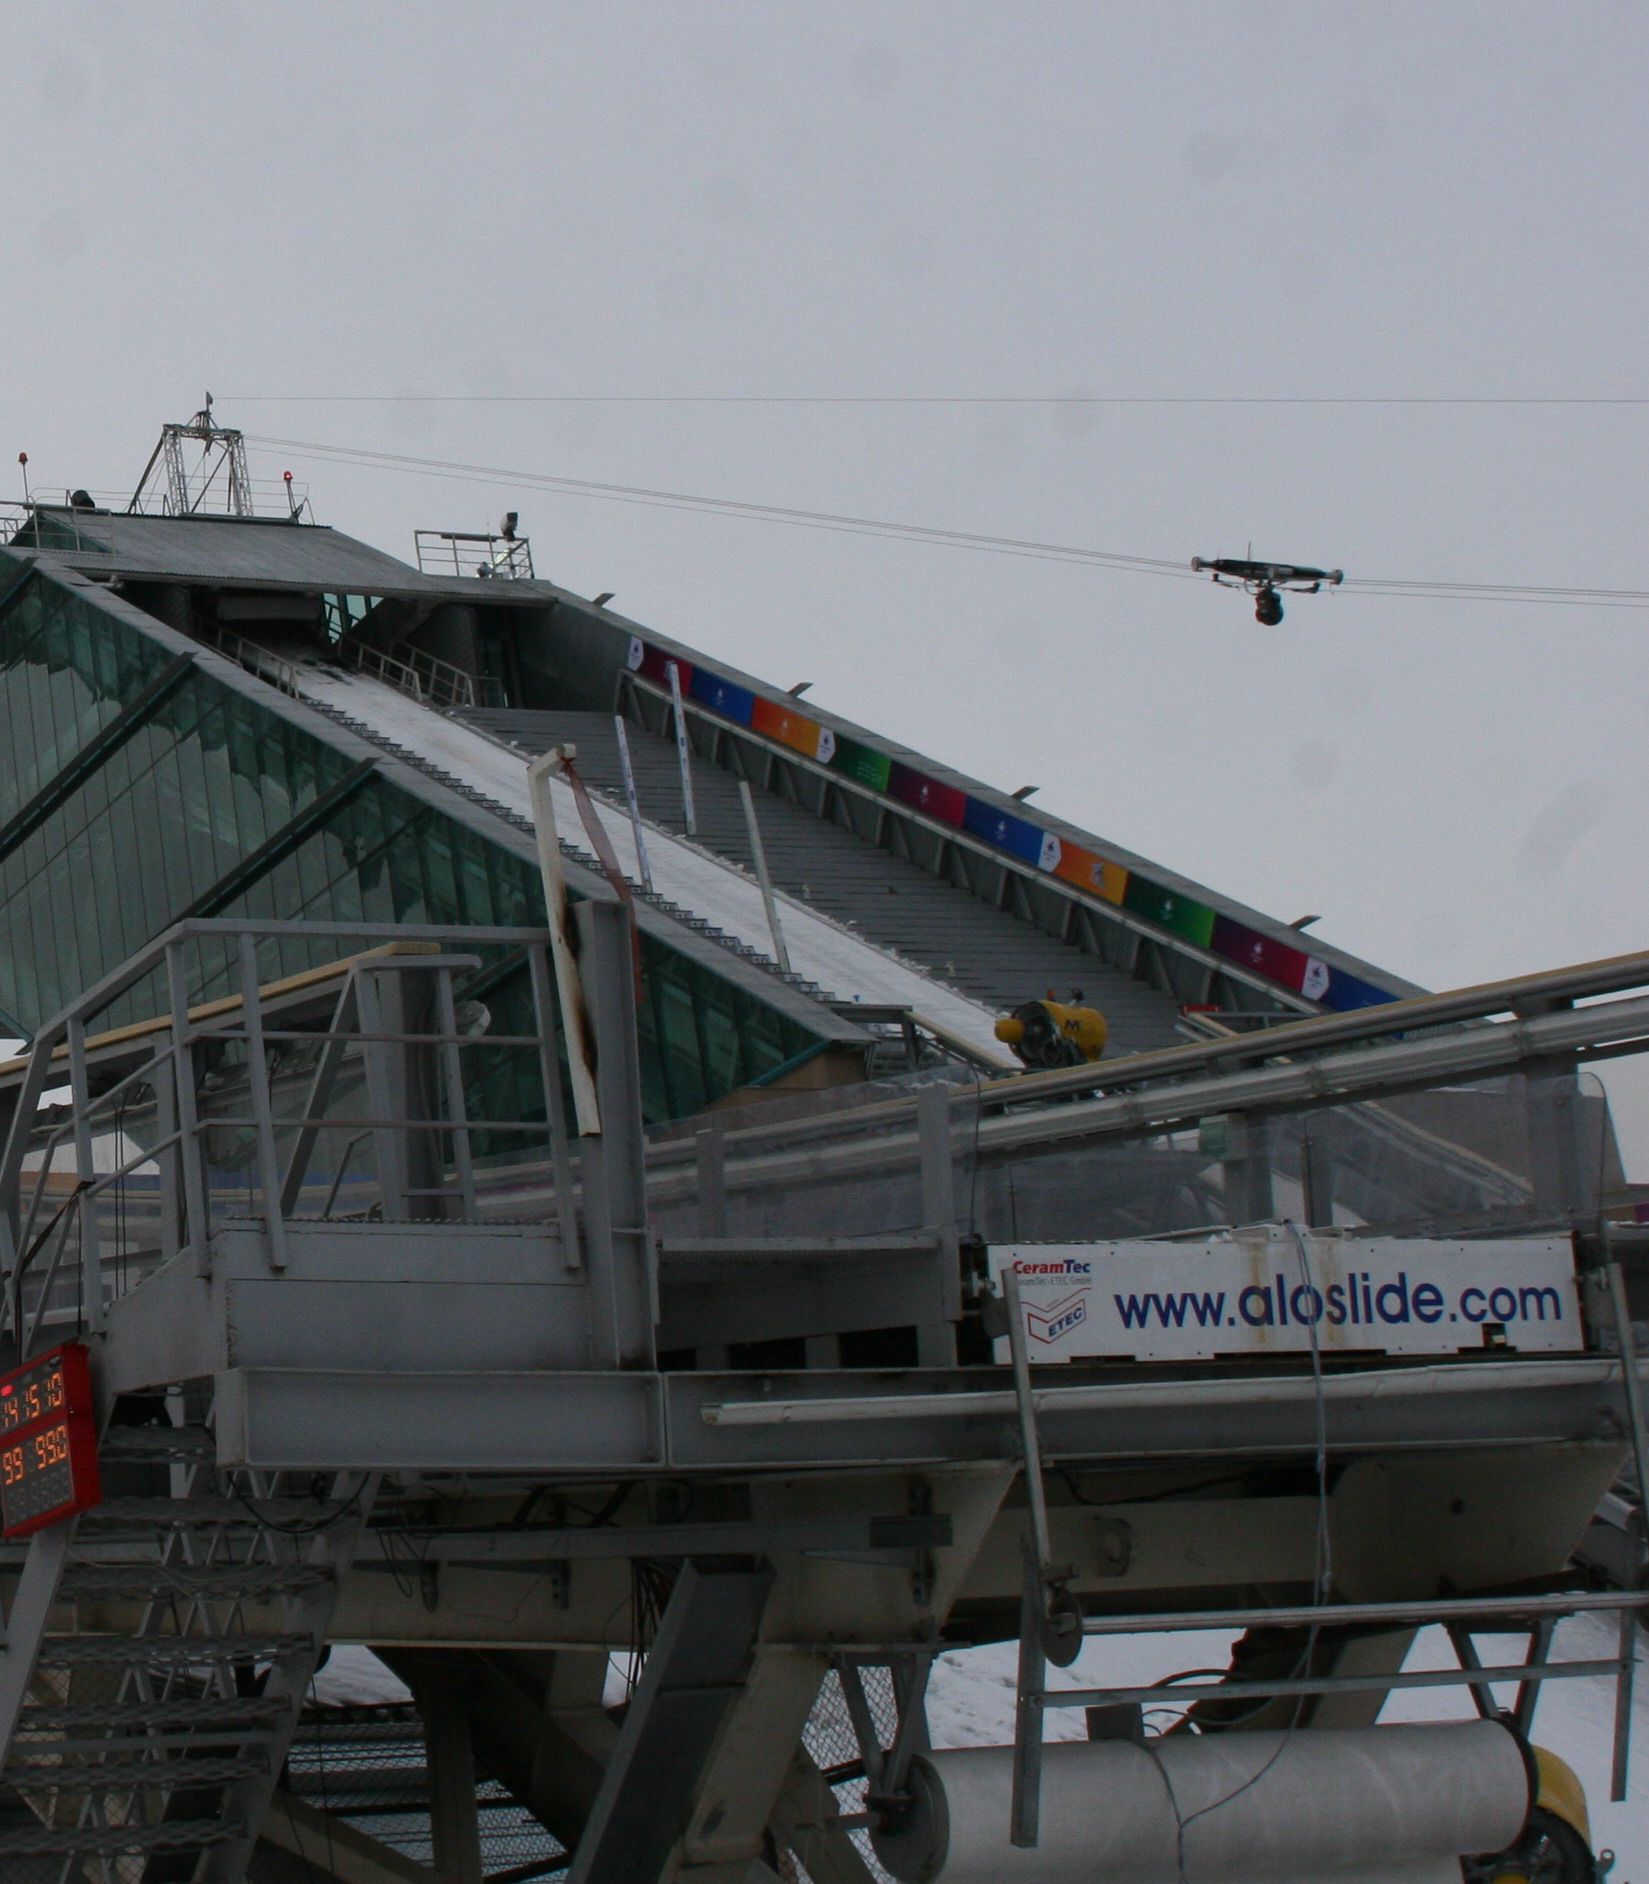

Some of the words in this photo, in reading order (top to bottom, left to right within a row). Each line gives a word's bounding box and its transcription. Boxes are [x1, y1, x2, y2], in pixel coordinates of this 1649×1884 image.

[1012, 1259, 1091, 1274] CeramTec
[1113, 1272, 1562, 1329] www.aloslide.com
[1049, 1306, 1084, 1337] ETEC
